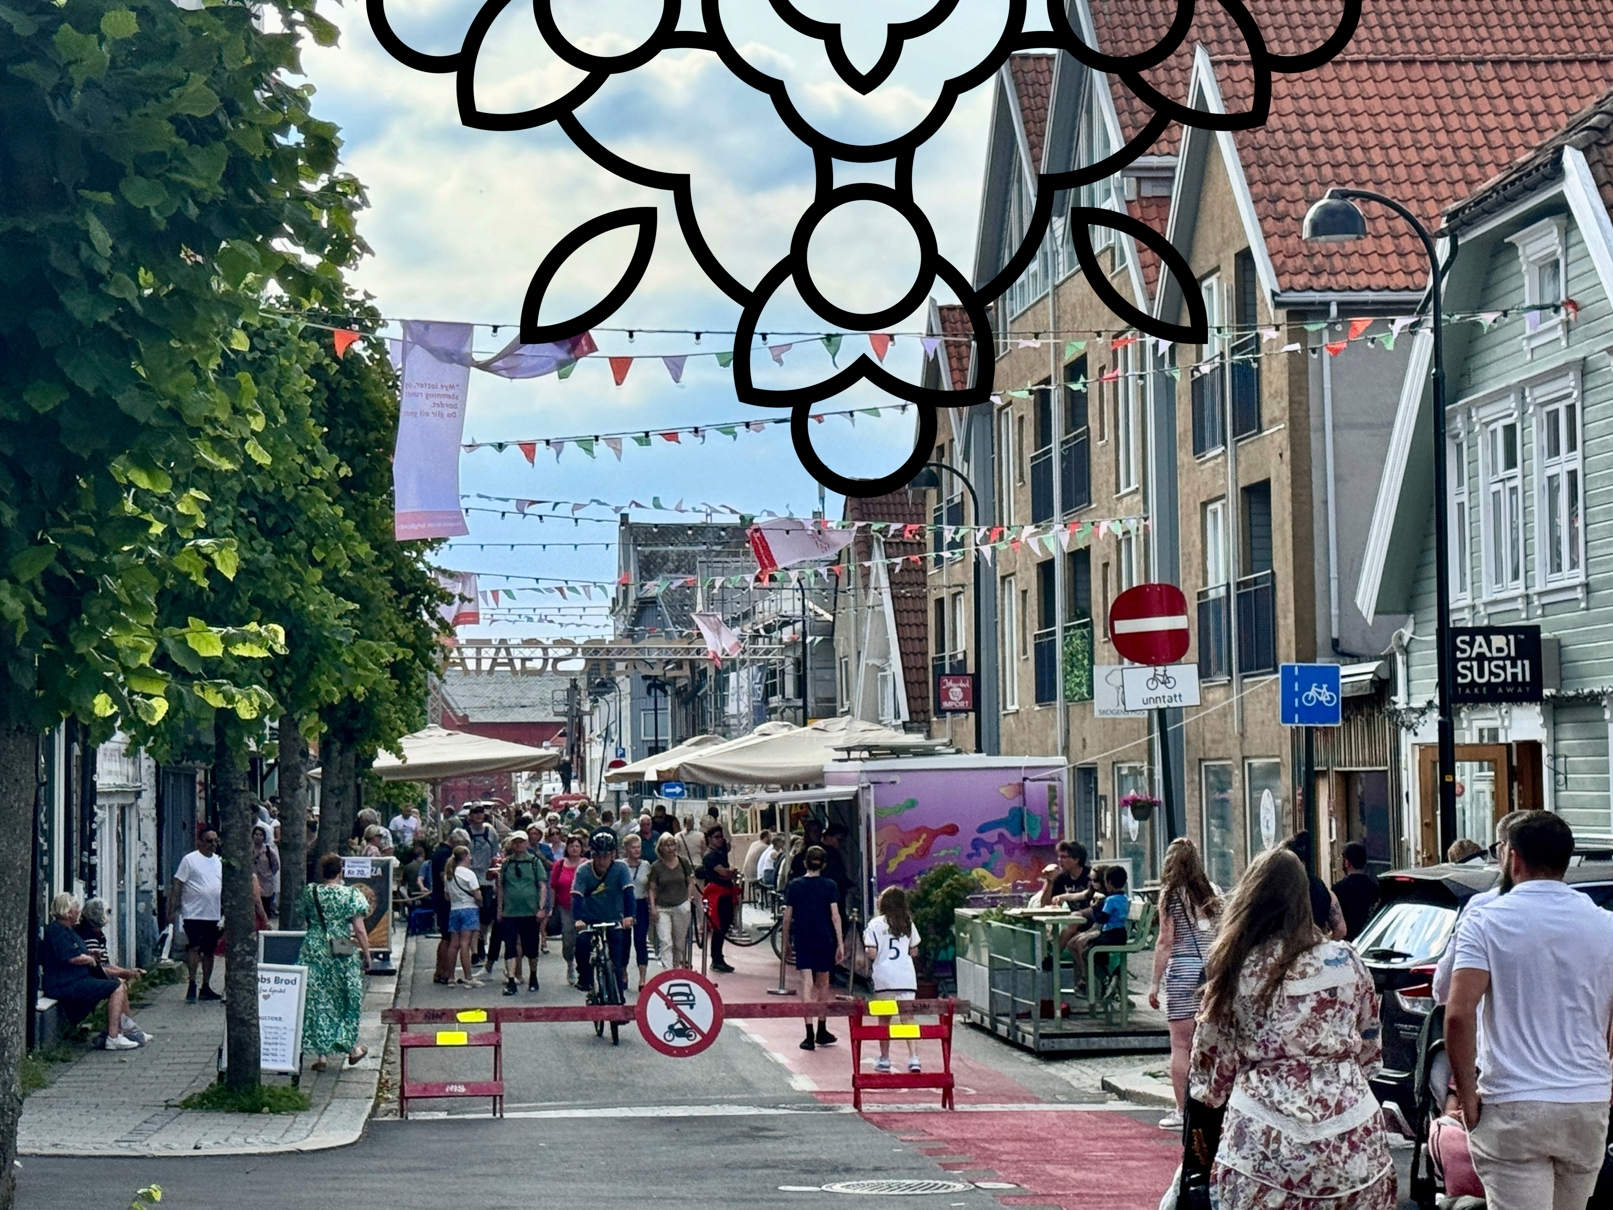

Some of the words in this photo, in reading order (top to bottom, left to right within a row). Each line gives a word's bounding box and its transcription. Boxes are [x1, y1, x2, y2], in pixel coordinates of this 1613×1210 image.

[1456, 635, 1516, 658] SABI
[1457, 660, 1531, 683] SUSHI
[1142, 692, 1183, 705] unntatt
[888, 937, 901, 960] 5
